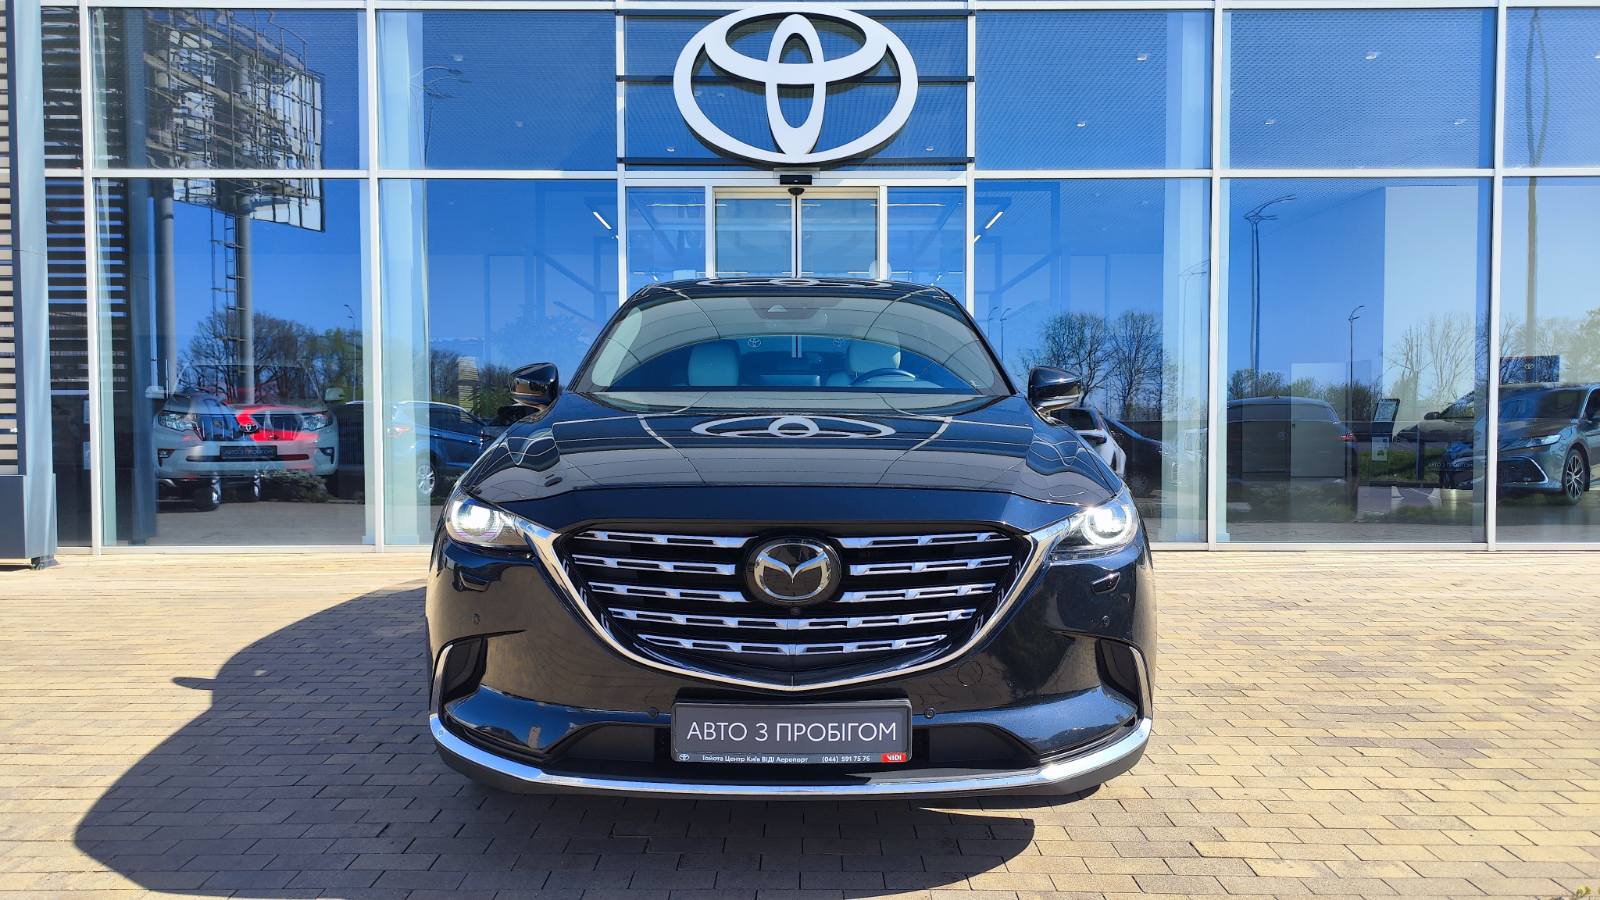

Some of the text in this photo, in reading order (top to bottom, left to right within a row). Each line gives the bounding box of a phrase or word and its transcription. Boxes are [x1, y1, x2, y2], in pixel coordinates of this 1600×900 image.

[686, 722, 897, 742] АВТО З ПРОБІГОМ
